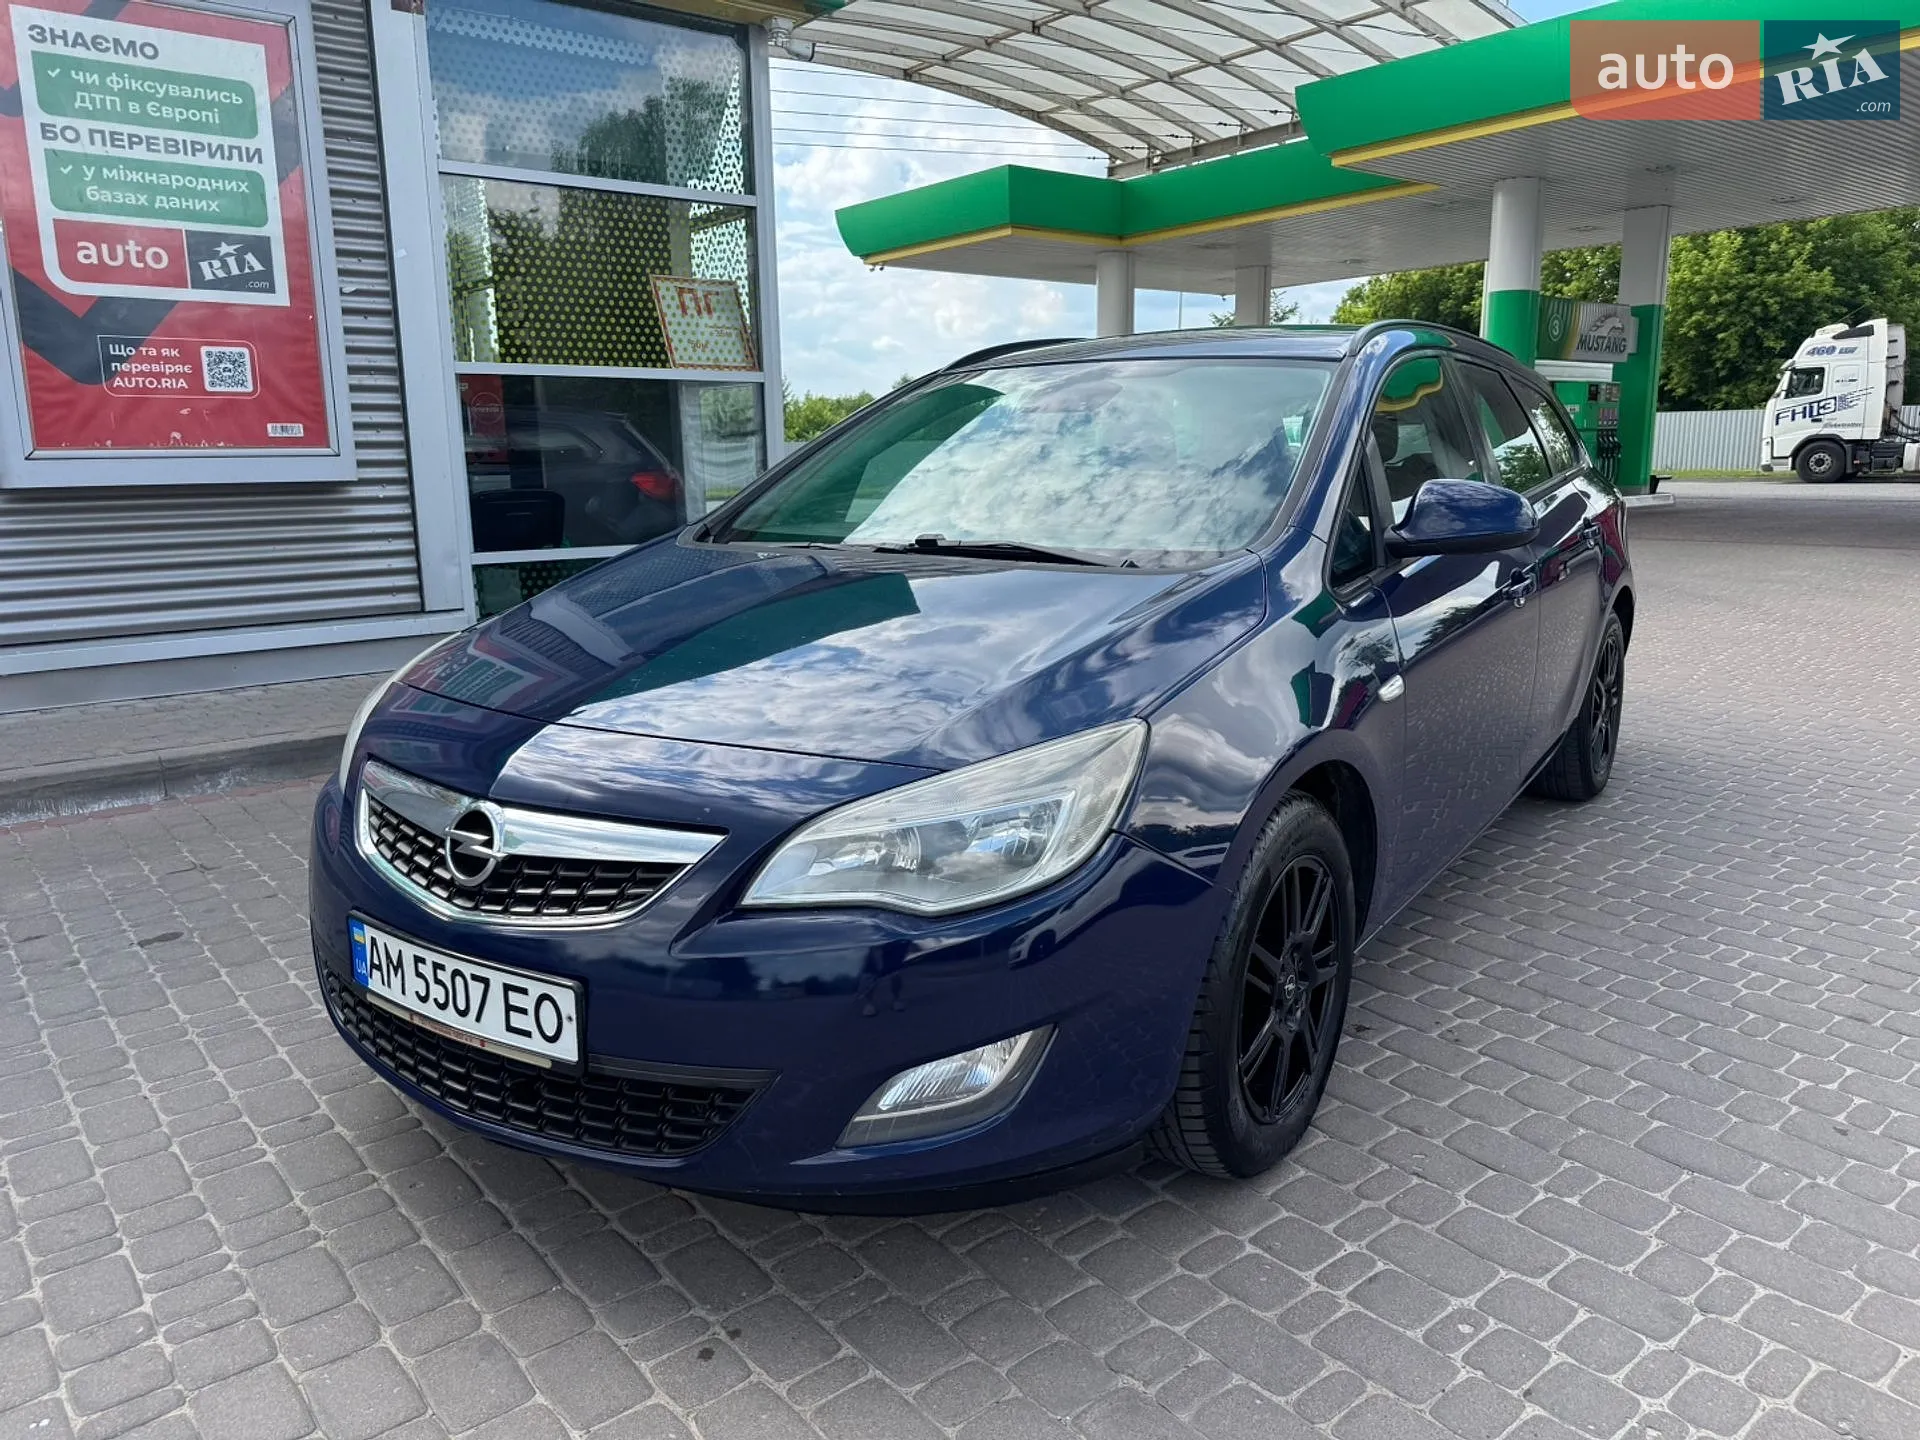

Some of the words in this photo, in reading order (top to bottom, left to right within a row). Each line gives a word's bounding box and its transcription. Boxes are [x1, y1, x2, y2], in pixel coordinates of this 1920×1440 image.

[27, 23, 160, 60] ЗНАЄМО
[71, 71, 100, 87] чи
[106, 71, 243, 106] фіксувались
[75, 92, 121, 112] ДТП
[128, 102, 141, 115] в
[146, 101, 220, 125] Європі
[40, 121, 81, 144] БО
[89, 127, 264, 165] ПЕРЕВІРИЛИ
[82, 164, 96, 181] у
[103, 164, 250, 194] міжнародних
[86, 185, 148, 207] базах
[155, 194, 220, 213] даних
[76, 239, 169, 270] auto
[198, 251, 267, 281] RIA
[1551, 320, 1560, 336] 3
[109, 343, 136, 357] Що
[139, 347, 158, 357] та
[160, 347, 180, 358] як
[1576, 333, 1627, 353] MUSTANG
[111, 359, 193, 376] перевіряє
[112, 376, 189, 390] AUTO.RIA
[356, 959, 367, 975] UA
[369, 935, 406, 996] AM
[413, 953, 490, 1024] 5507
[502, 981, 564, 1044] EO
